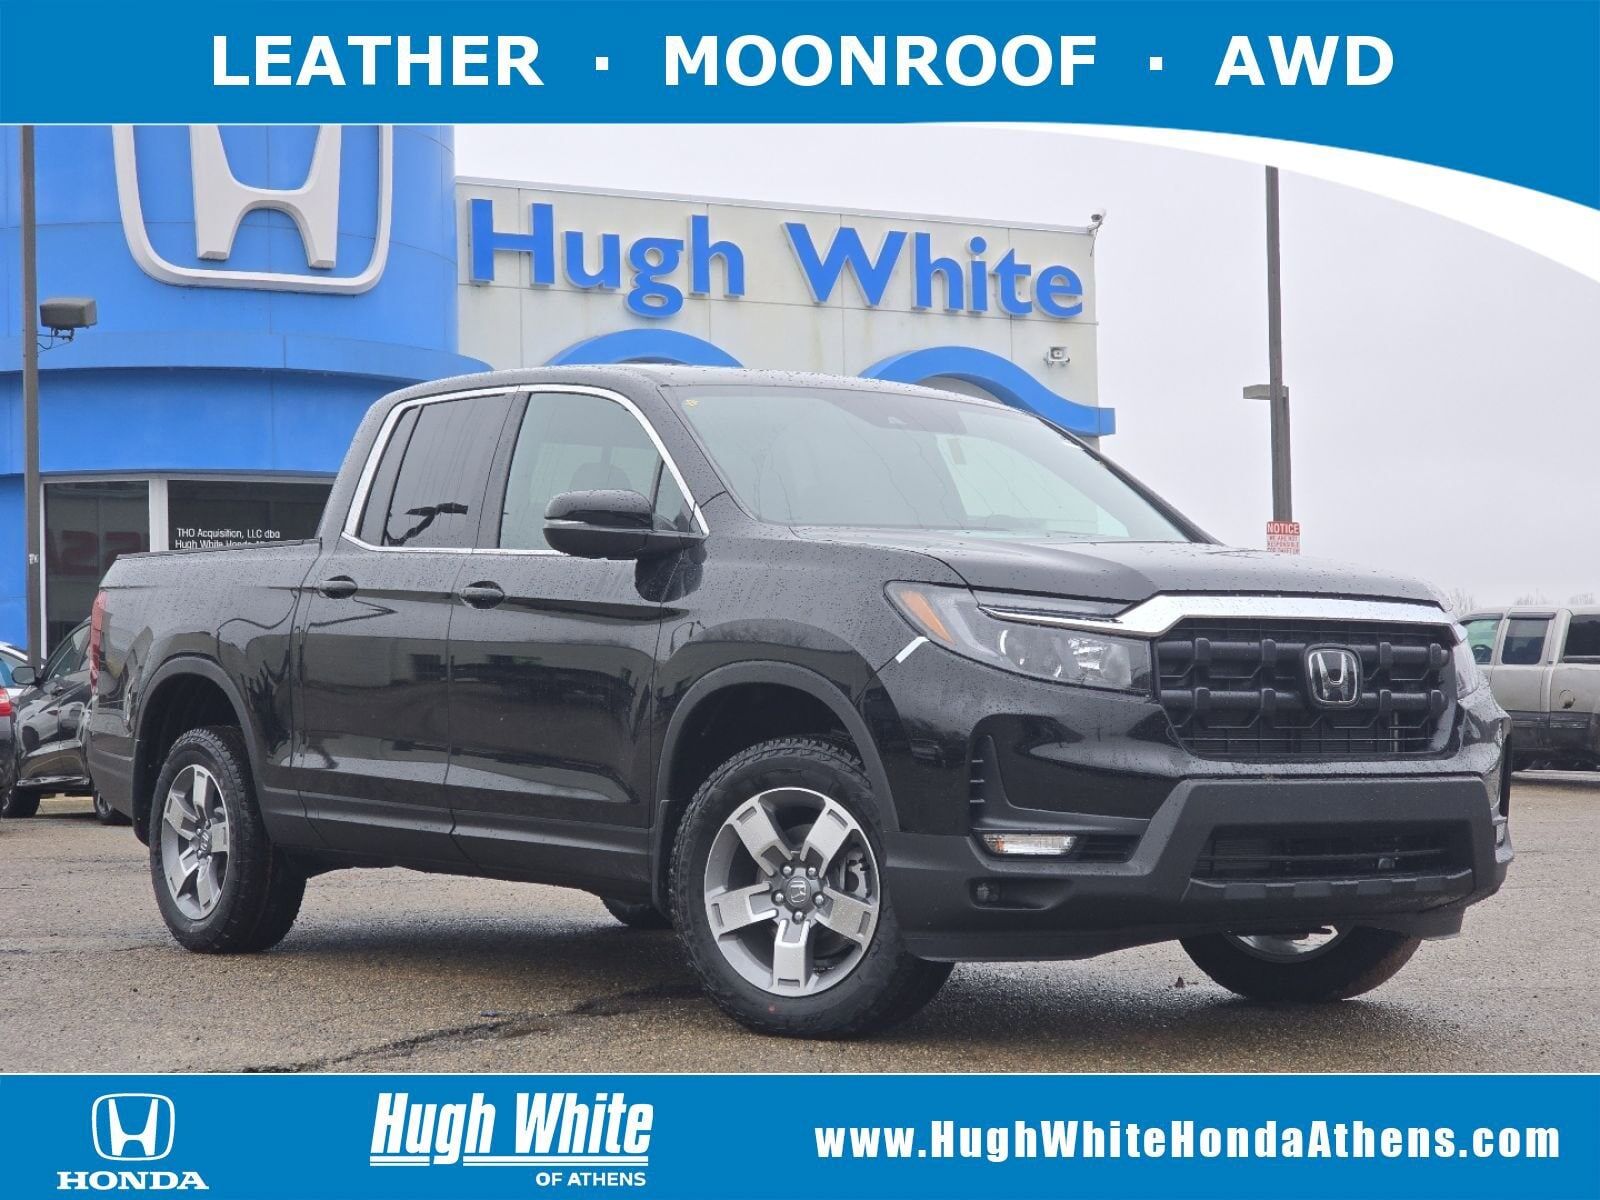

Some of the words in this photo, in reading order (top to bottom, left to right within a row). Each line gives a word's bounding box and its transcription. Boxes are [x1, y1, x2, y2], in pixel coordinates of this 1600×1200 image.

[469, 199, 745, 318] Hugh
[782, 221, 1083, 318] White
[177, 528, 195, 538] THO
[197, 528, 244, 540] Acquisition,
[247, 529, 262, 539] LLC
[264, 529, 280, 539] dba
[1267, 523, 1299, 534] NOTICE
[175, 540, 197, 550] Hugh
